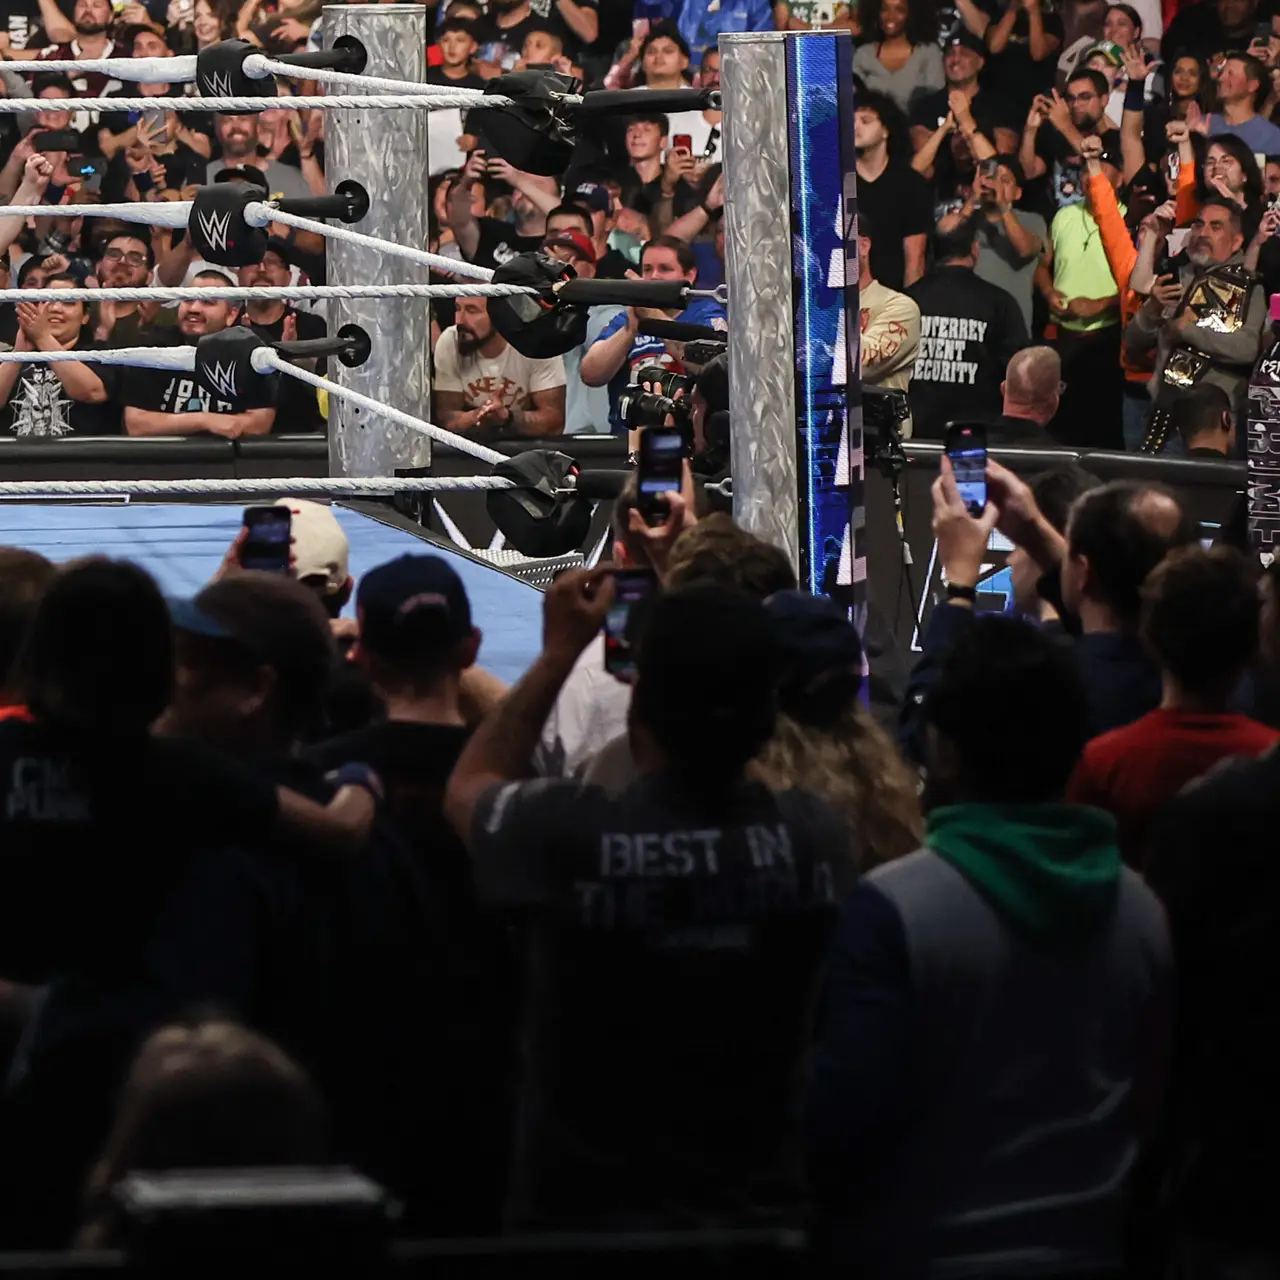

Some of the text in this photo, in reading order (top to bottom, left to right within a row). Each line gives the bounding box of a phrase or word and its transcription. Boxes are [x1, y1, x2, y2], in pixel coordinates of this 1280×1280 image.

[920, 316, 988, 342] NTERREY
[918, 338, 966, 361] EVENT
[600, 823, 795, 877] BEST IN
